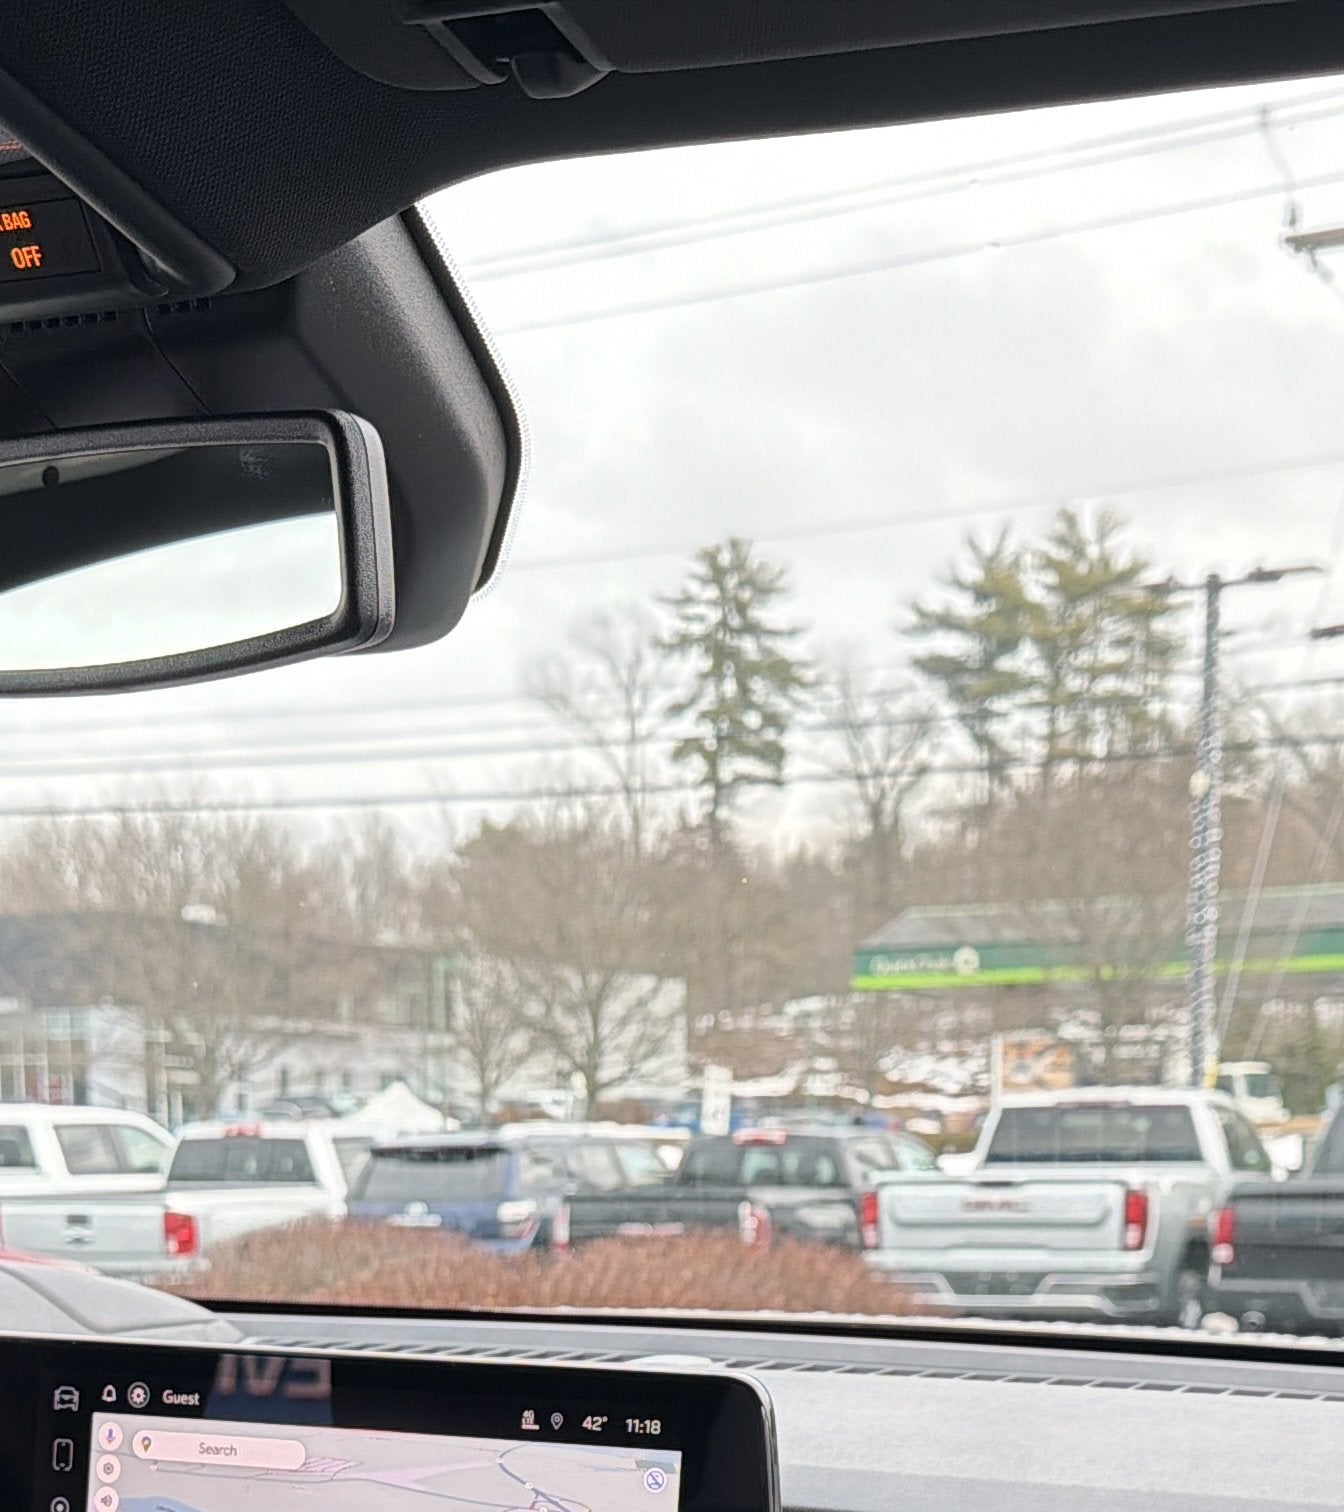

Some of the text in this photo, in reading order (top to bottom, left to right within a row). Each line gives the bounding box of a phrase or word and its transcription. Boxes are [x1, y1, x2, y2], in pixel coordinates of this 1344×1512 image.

[2, 211, 32, 231] BAG
[10, 245, 43, 269] OFF
[162, 1389, 201, 1406] Guest
[582, 1416, 662, 1435] 42° 11:18
[199, 1442, 238, 1457] Search
